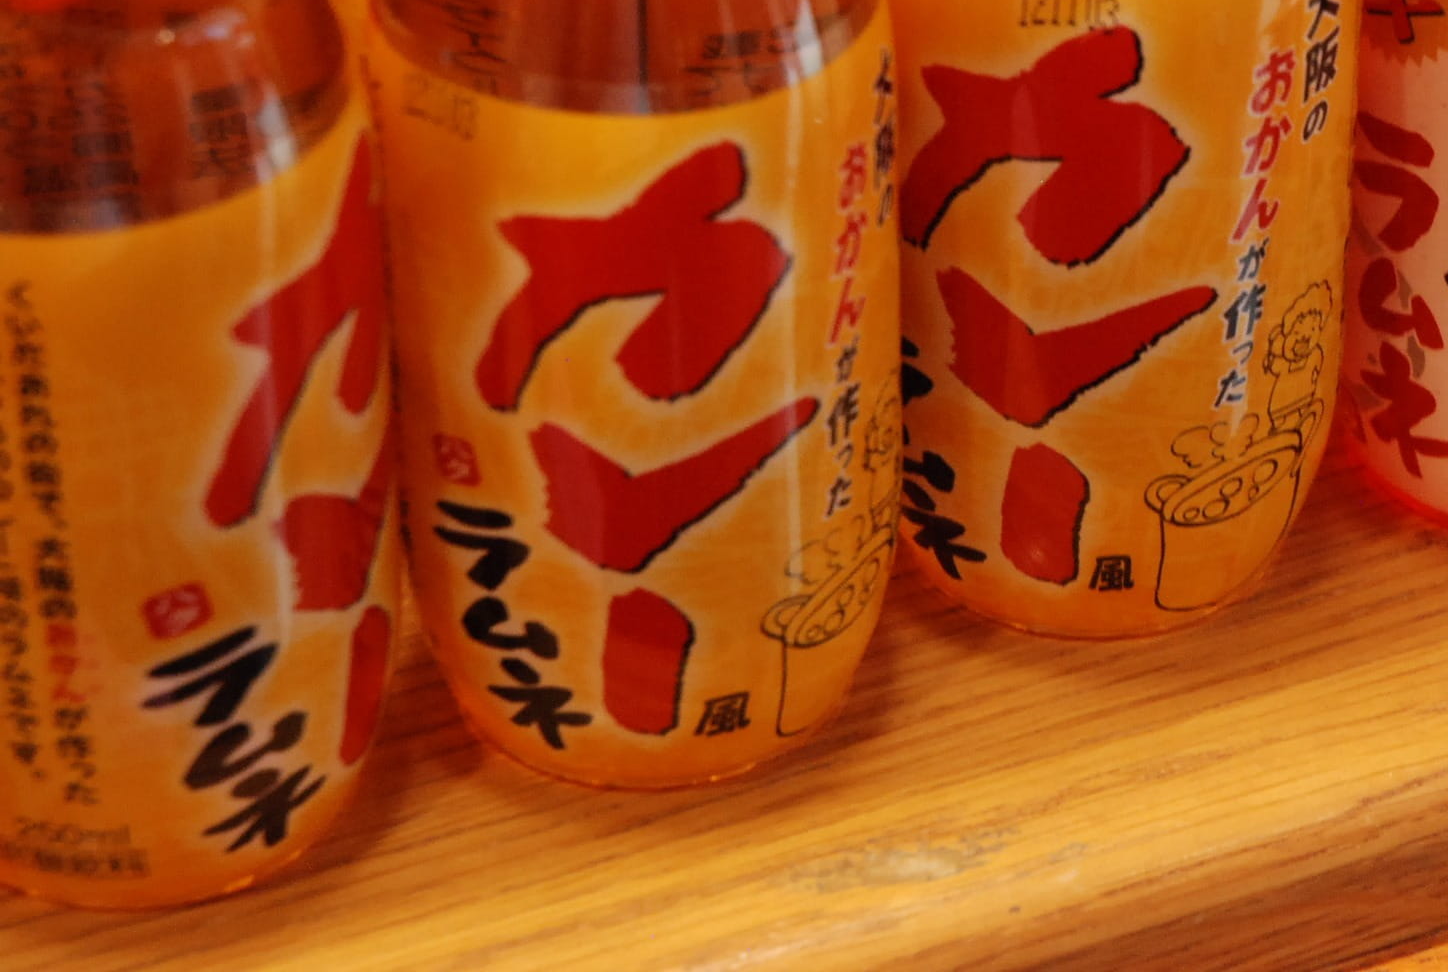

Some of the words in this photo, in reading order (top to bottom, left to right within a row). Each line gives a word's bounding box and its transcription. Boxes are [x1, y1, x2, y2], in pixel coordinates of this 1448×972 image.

[825, 144, 867, 517] おかんが作った
[1214, 50, 1297, 409] おかんが作った
[432, 500, 593, 750] ラムネ
[1088, 554, 1135, 592] 風
[142, 625, 328, 854] ラムネ
[694, 693, 750, 739] 風
